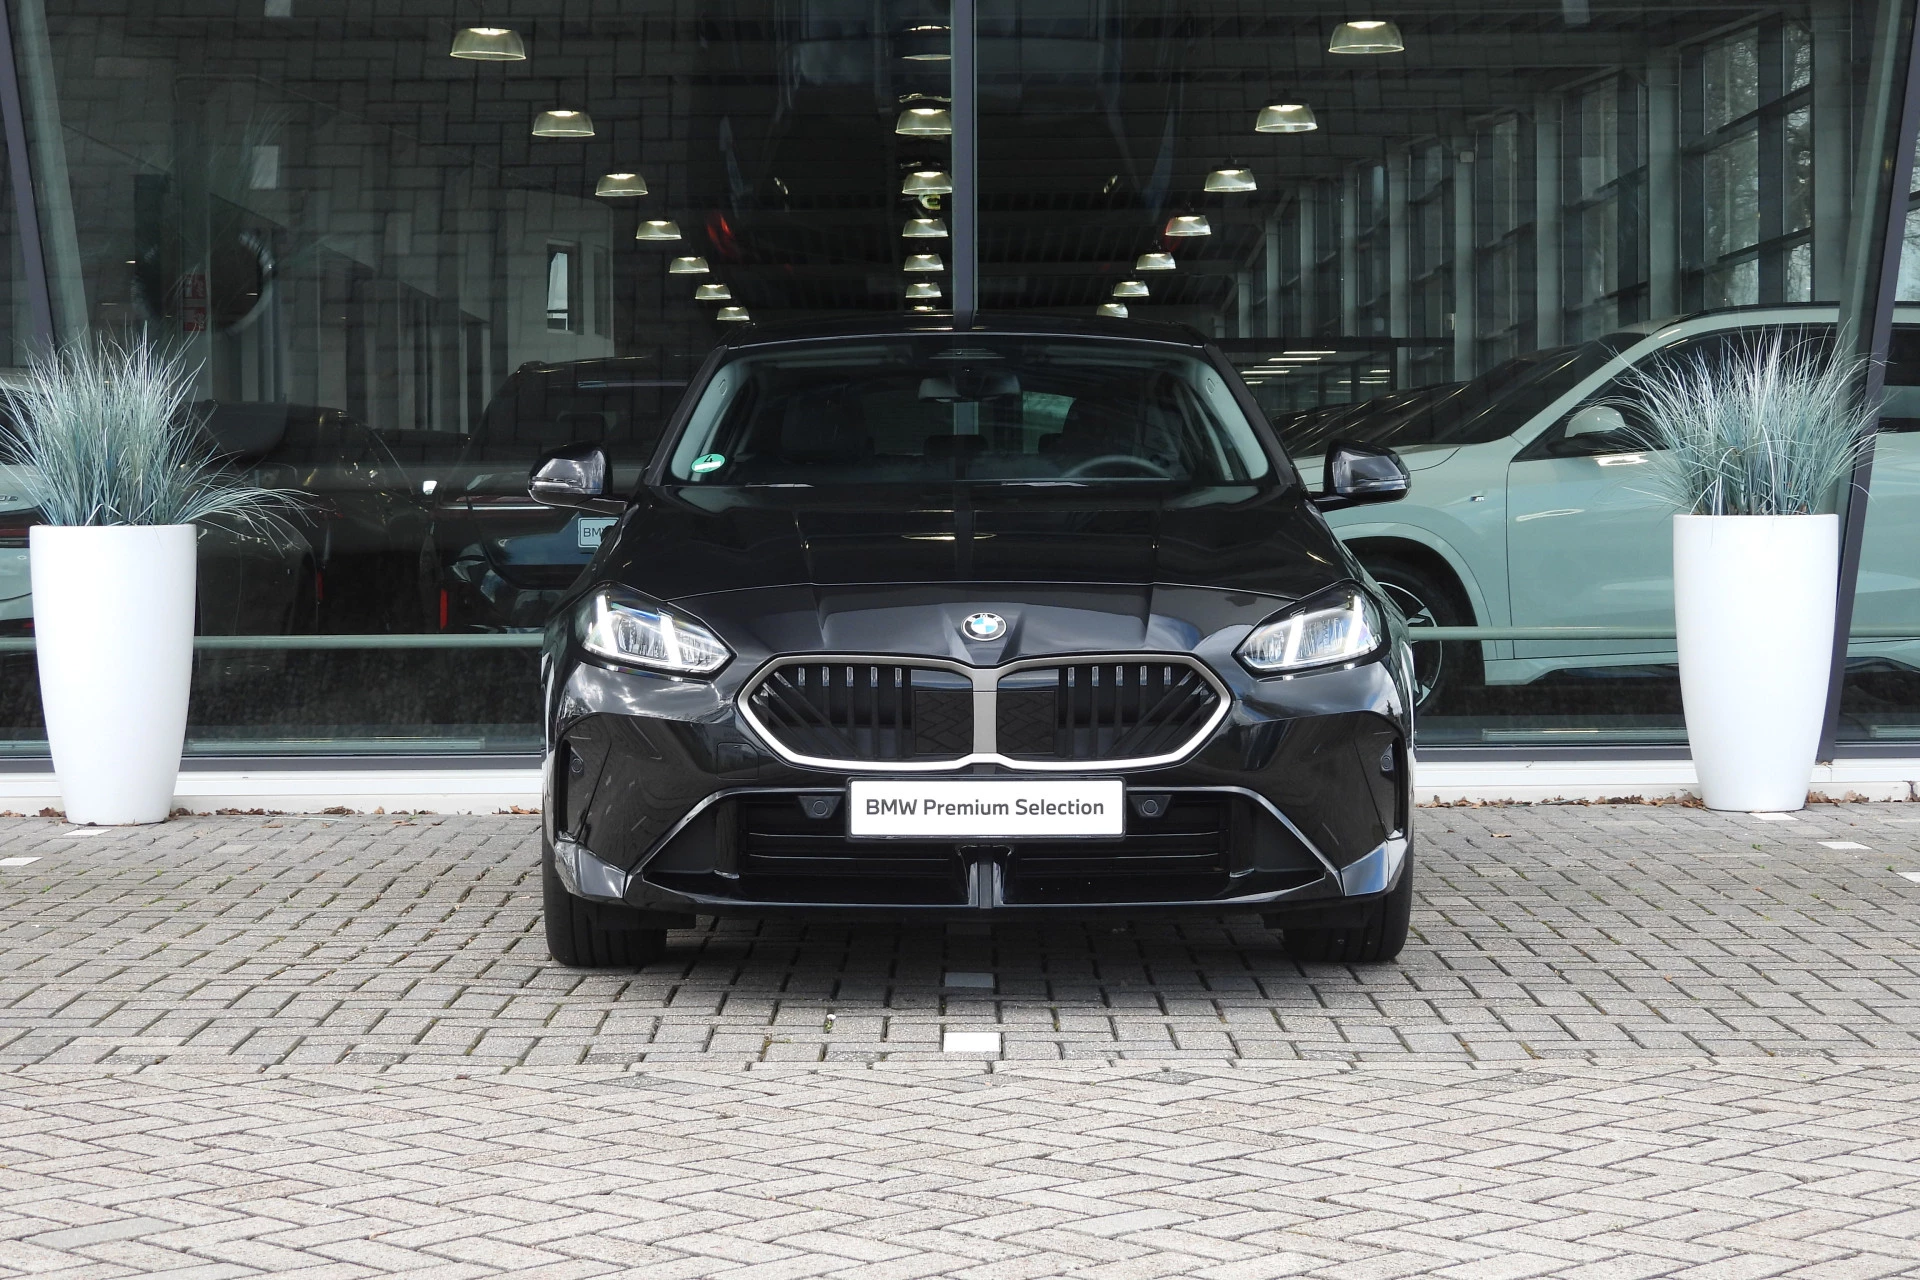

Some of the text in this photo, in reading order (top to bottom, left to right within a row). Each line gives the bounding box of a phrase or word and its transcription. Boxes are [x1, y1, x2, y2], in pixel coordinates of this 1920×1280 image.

[583, 527, 604, 538] BM
[866, 799, 1104, 815] BMW Premium Selection
